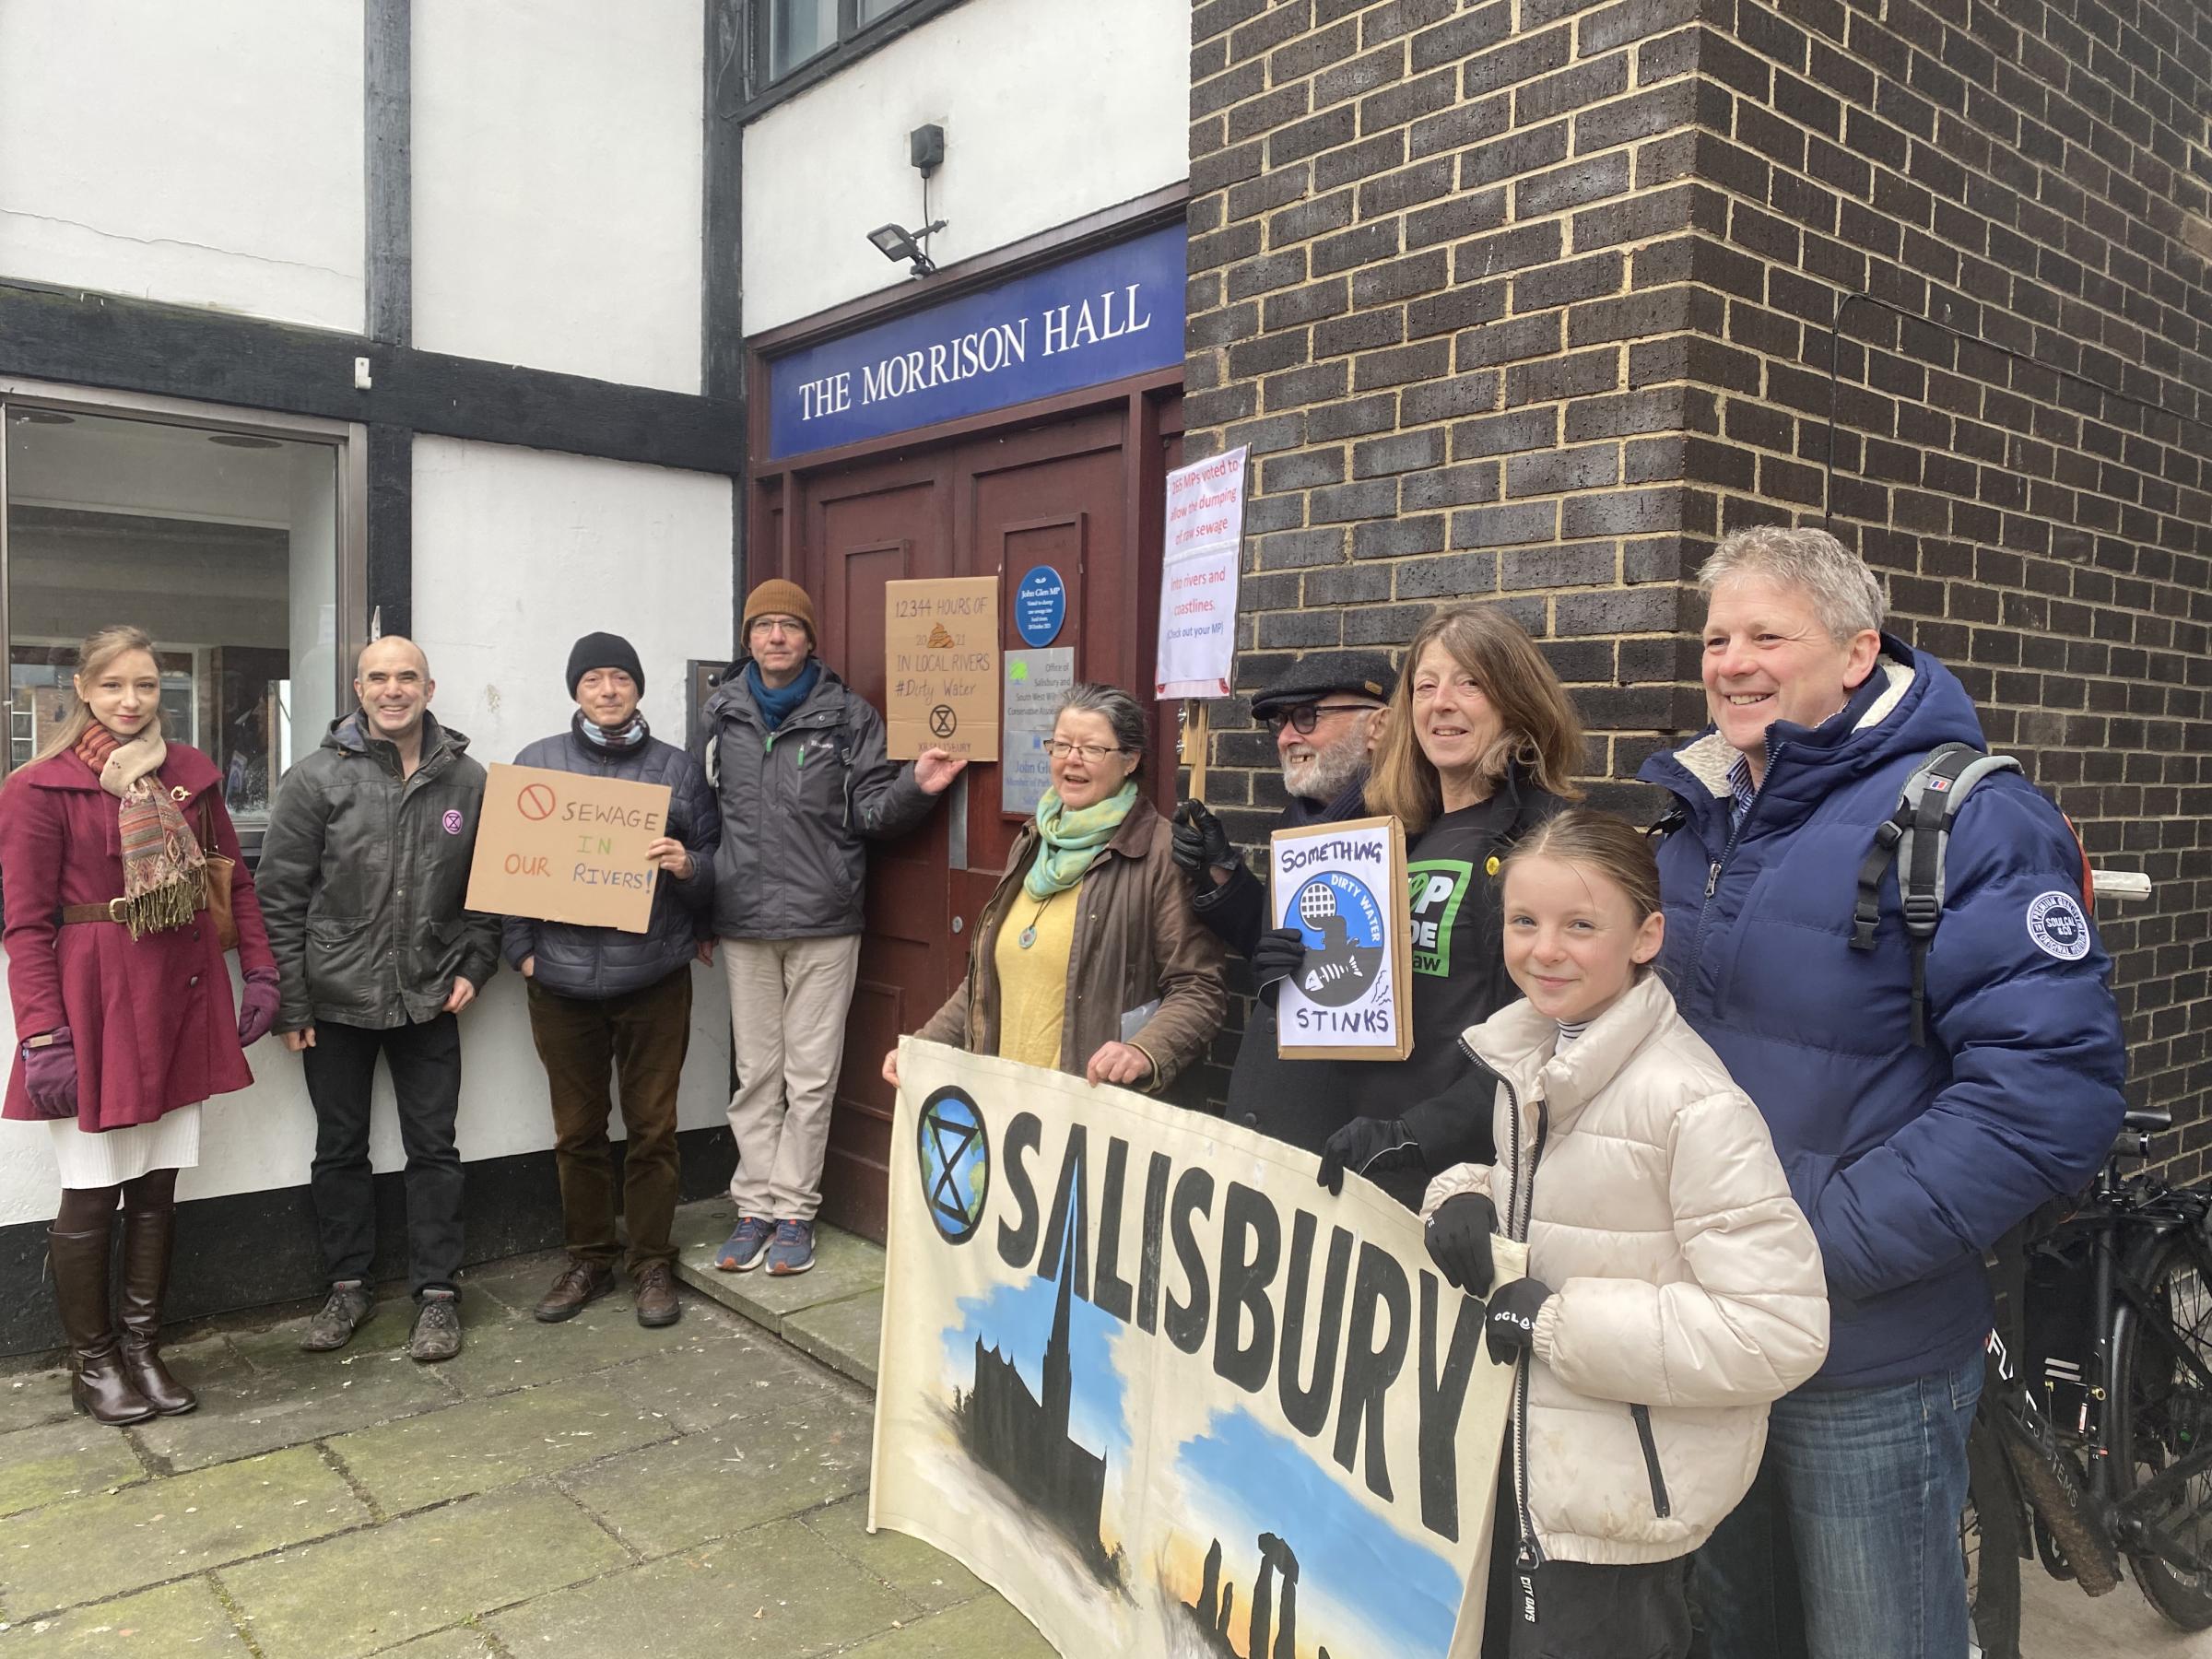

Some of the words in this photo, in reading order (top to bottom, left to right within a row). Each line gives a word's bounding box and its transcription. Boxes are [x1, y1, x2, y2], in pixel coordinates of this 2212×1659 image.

[798, 372, 852, 421] THE
[862, 318, 1030, 405] MORRISON
[1042, 283, 1152, 357] HALL
[1183, 472, 1201, 488] MPs
[1202, 460, 1226, 481] voted
[1228, 459, 1239, 473] to
[1171, 506, 1187, 522] allow
[1188, 500, 1197, 514] the
[1199, 488, 1237, 510] dumping
[1175, 530, 1182, 546] of
[1183, 530, 1194, 542] raw
[1195, 517, 1228, 536] sewage
[1171, 576, 1182, 591] into
[1183, 572, 1206, 587] rivers
[1208, 566, 1226, 582] and
[1021, 589, 1034, 599] John
[1035, 588, 1049, 597] Glen
[1050, 586, 1061, 595] MP
[896, 598, 932, 618] 12344
[937, 597, 971, 616] HOURS
[973, 596, 989, 615] OF
[1174, 598, 1215, 616] coastlines.
[916, 634, 927, 646] 20
[956, 633, 966, 646] 21
[1182, 627, 1193, 638] out
[1194, 626, 1210, 639] your
[897, 654, 912, 672] IN
[915, 653, 950, 672] LOCAL
[952, 653, 990, 672] RIVERS
[1045, 663, 1062, 672] Office
[1063, 662, 1070, 672] of
[895, 678, 935, 706] #Dirty
[943, 678, 977, 698] Water
[1034, 677, 1059, 688] Salisbury
[1060, 677, 1071, 687] and
[1016, 692, 1031, 701] South
[1032, 692, 1046, 701] West
[1017, 760, 1035, 774] John
[561, 802, 659, 830] SEWAGE
[577, 835, 612, 855] IN
[1281, 841, 1382, 873] SOMETHING
[504, 853, 550, 877] OUR
[573, 863, 653, 894] RIVERS!
[1331, 874, 1361, 898] DIRTY
[1360, 894, 1380, 942] WATER
[2032, 897, 2057, 921] PREMIUM
[2045, 916, 2076, 928] SOULCAL
[2039, 934, 2072, 955] ORIGINAL
[1413, 954, 1441, 971] aw
[1296, 1008, 1389, 1033] STINKS
[997, 1111, 1486, 1543] SALISBURY
[1520, 1576, 1535, 1597] CITY
[1524, 1596, 1535, 1623] DAYS
